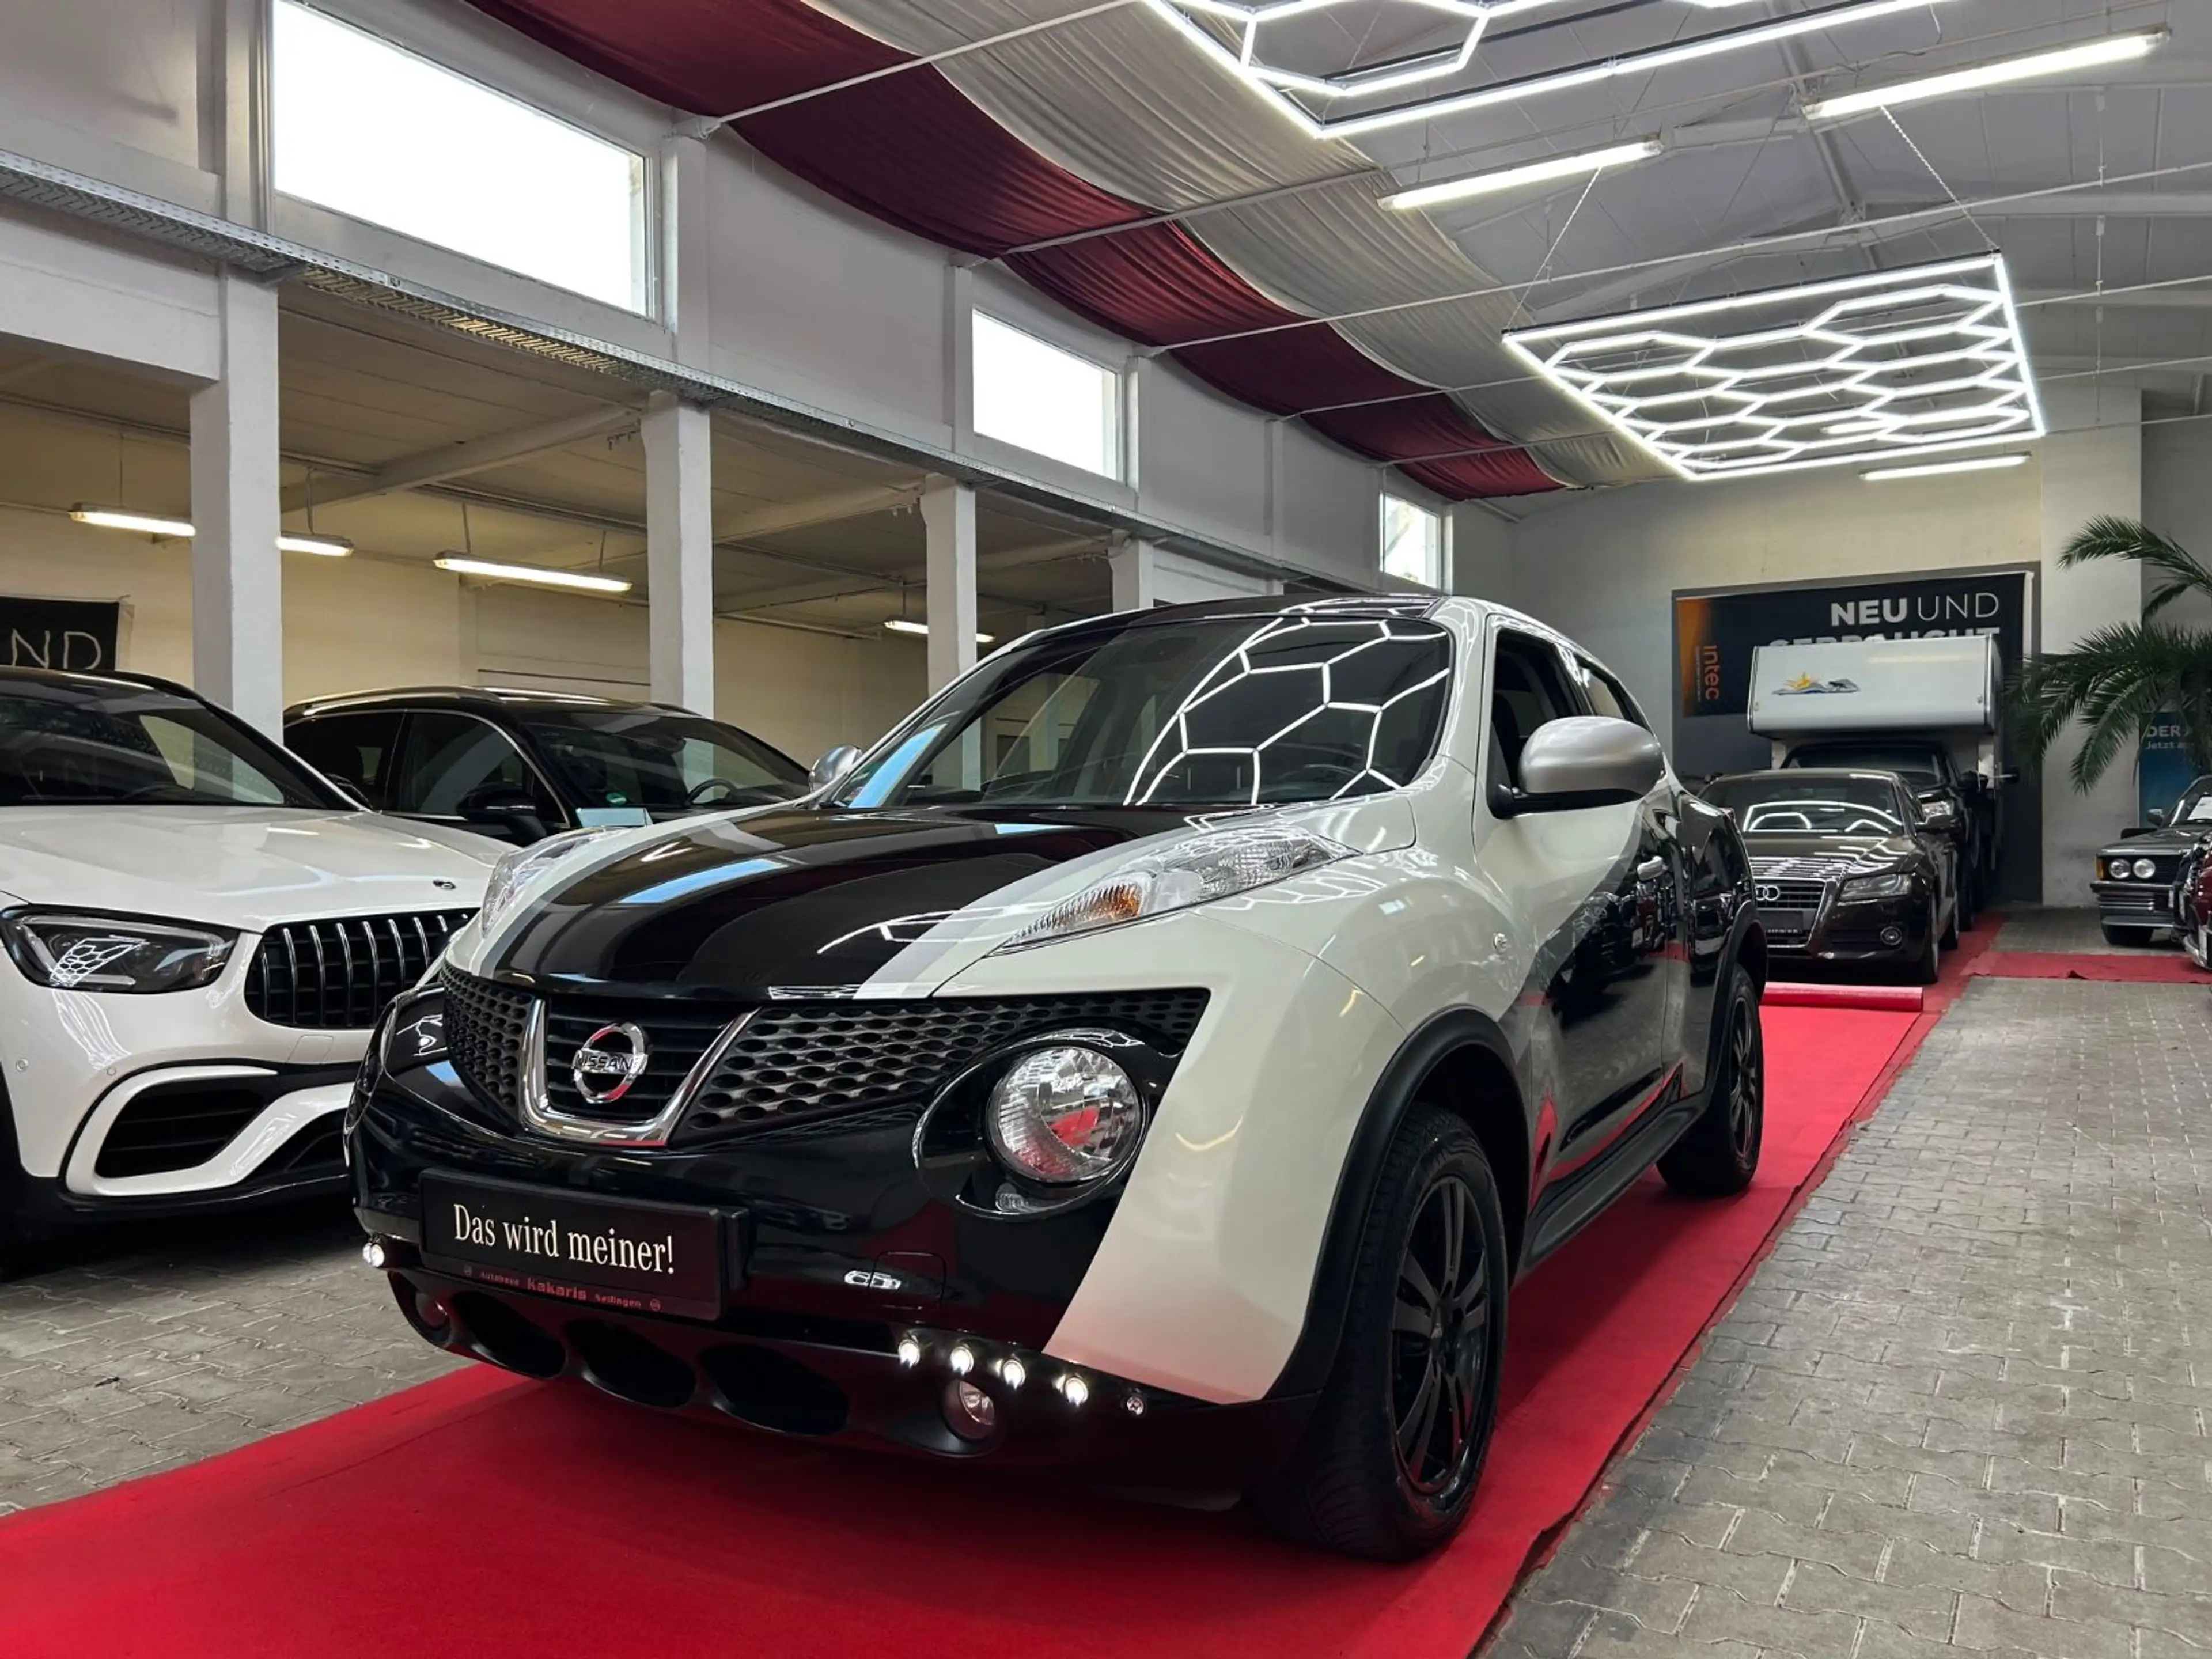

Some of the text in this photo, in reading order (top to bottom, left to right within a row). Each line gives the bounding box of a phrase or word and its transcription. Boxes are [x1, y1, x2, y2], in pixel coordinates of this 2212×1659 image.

[1831, 593, 1999, 626] NEU UND
[1703, 645, 1721, 700] intec
[577, 1052, 634, 1073] NISSAN
[454, 1203, 675, 1274] Das wird meiner!
[527, 1277, 588, 1301] Kakaris
